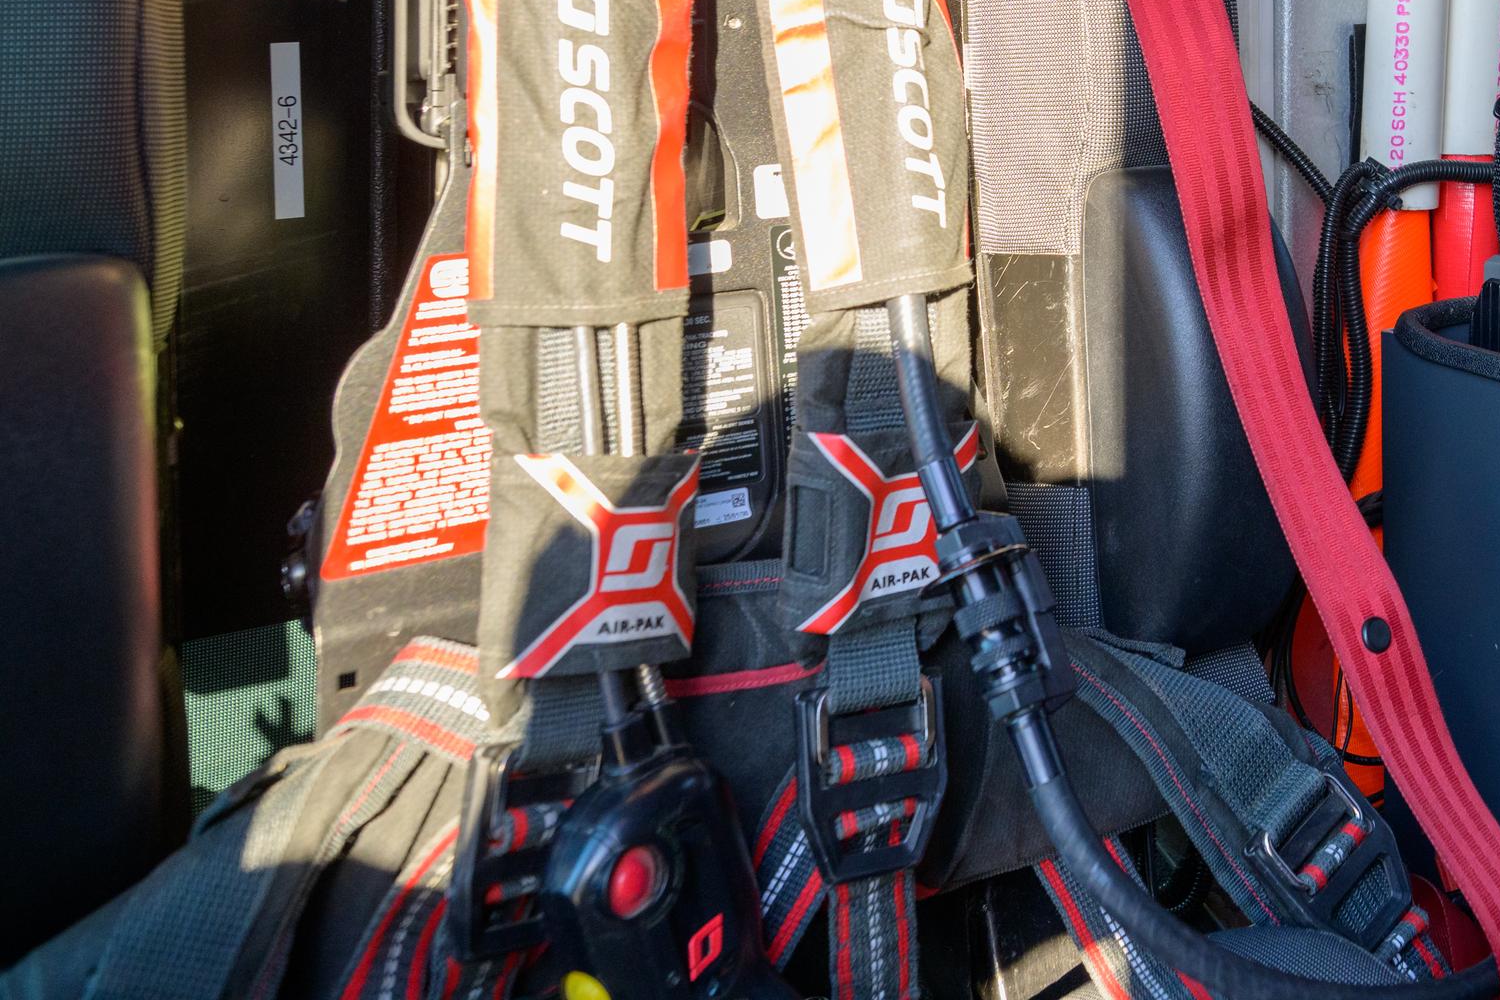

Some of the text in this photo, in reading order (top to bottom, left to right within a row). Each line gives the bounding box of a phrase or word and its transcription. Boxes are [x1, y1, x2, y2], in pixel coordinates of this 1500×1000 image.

[1392, 91, 1407, 130] SCH
[277, 95, 300, 166] 4342-6
[871, 566, 931, 590] AIR-PAK
[598, 614, 666, 636] AIR-PAK
